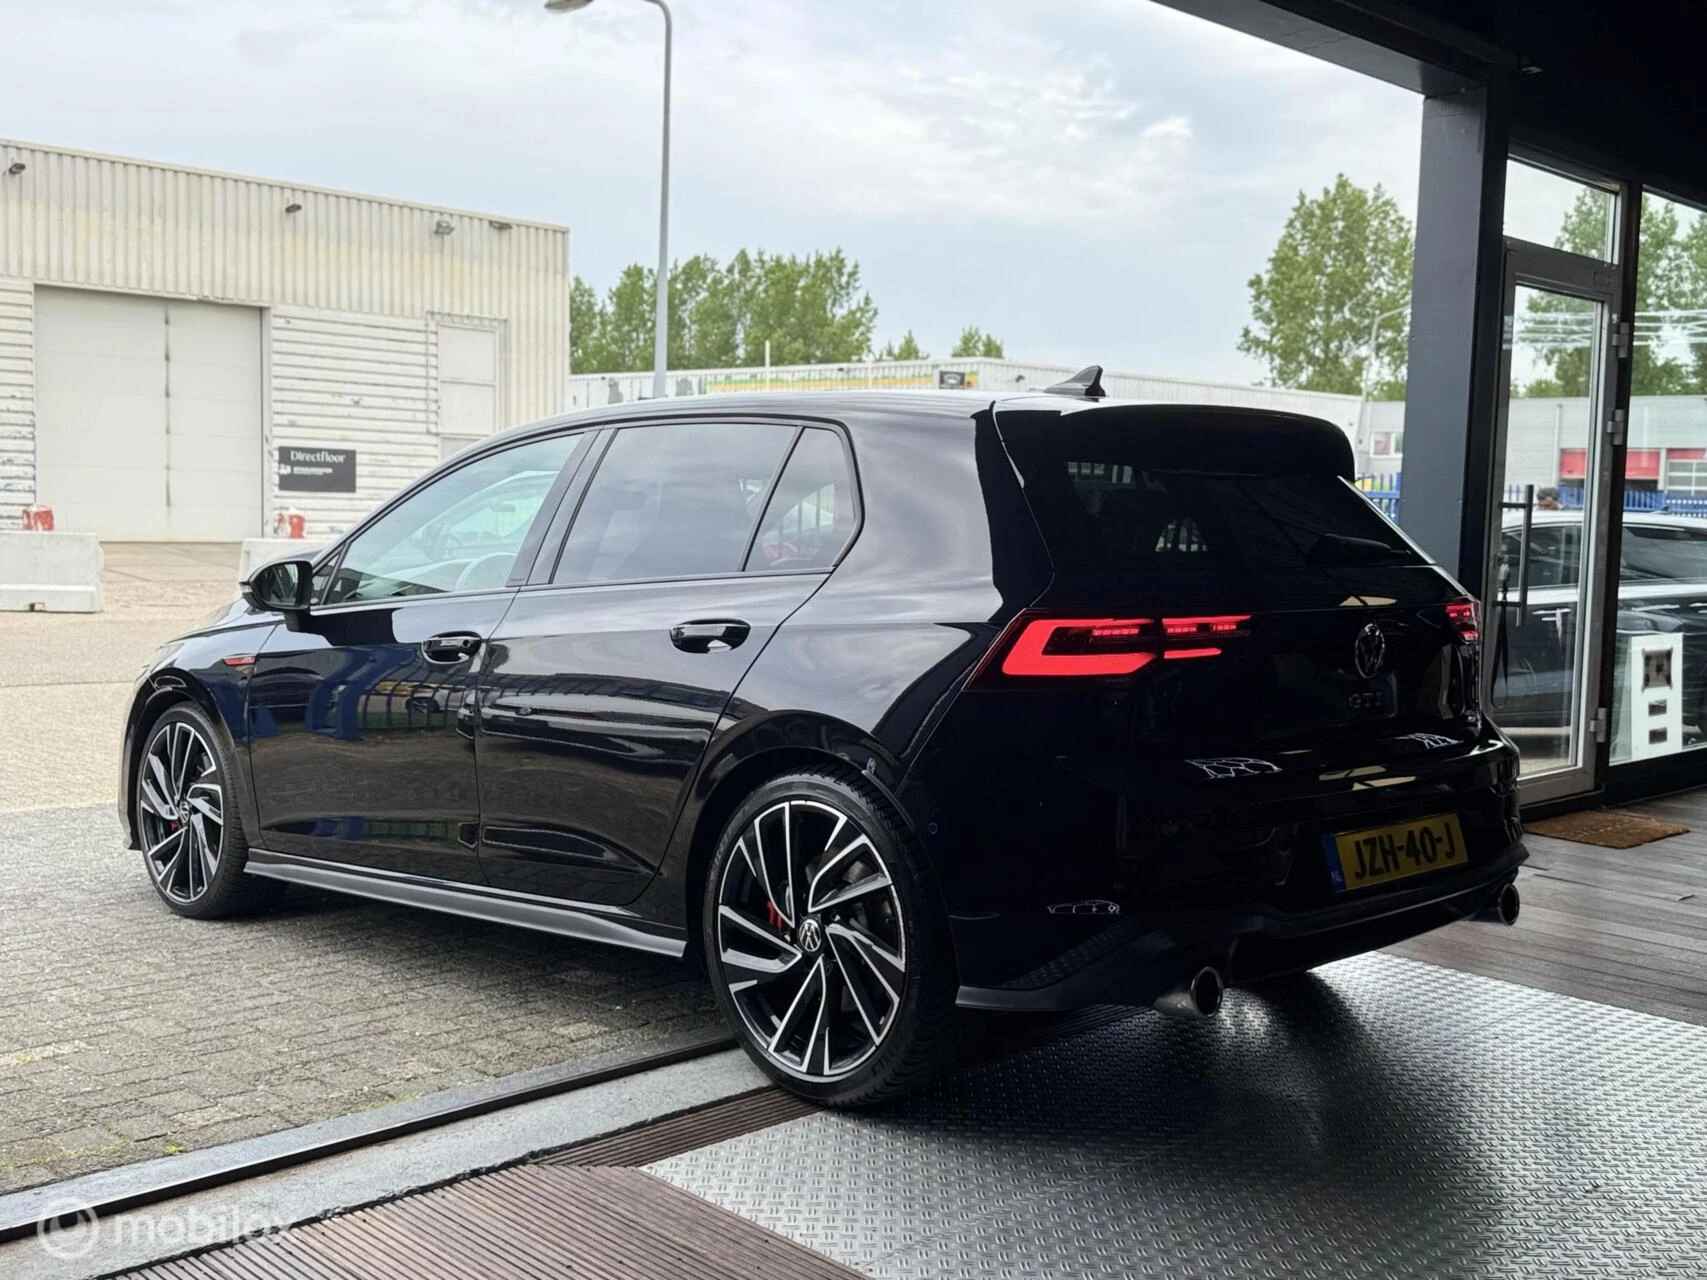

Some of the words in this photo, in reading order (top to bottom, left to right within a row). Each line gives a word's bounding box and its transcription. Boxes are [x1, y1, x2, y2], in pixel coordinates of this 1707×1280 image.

[290, 450, 347, 463] Directfloor
[1348, 692, 1383, 708] GTI
[1354, 822, 1456, 880] JZH-40-J
[1330, 871, 1344, 883] NL
